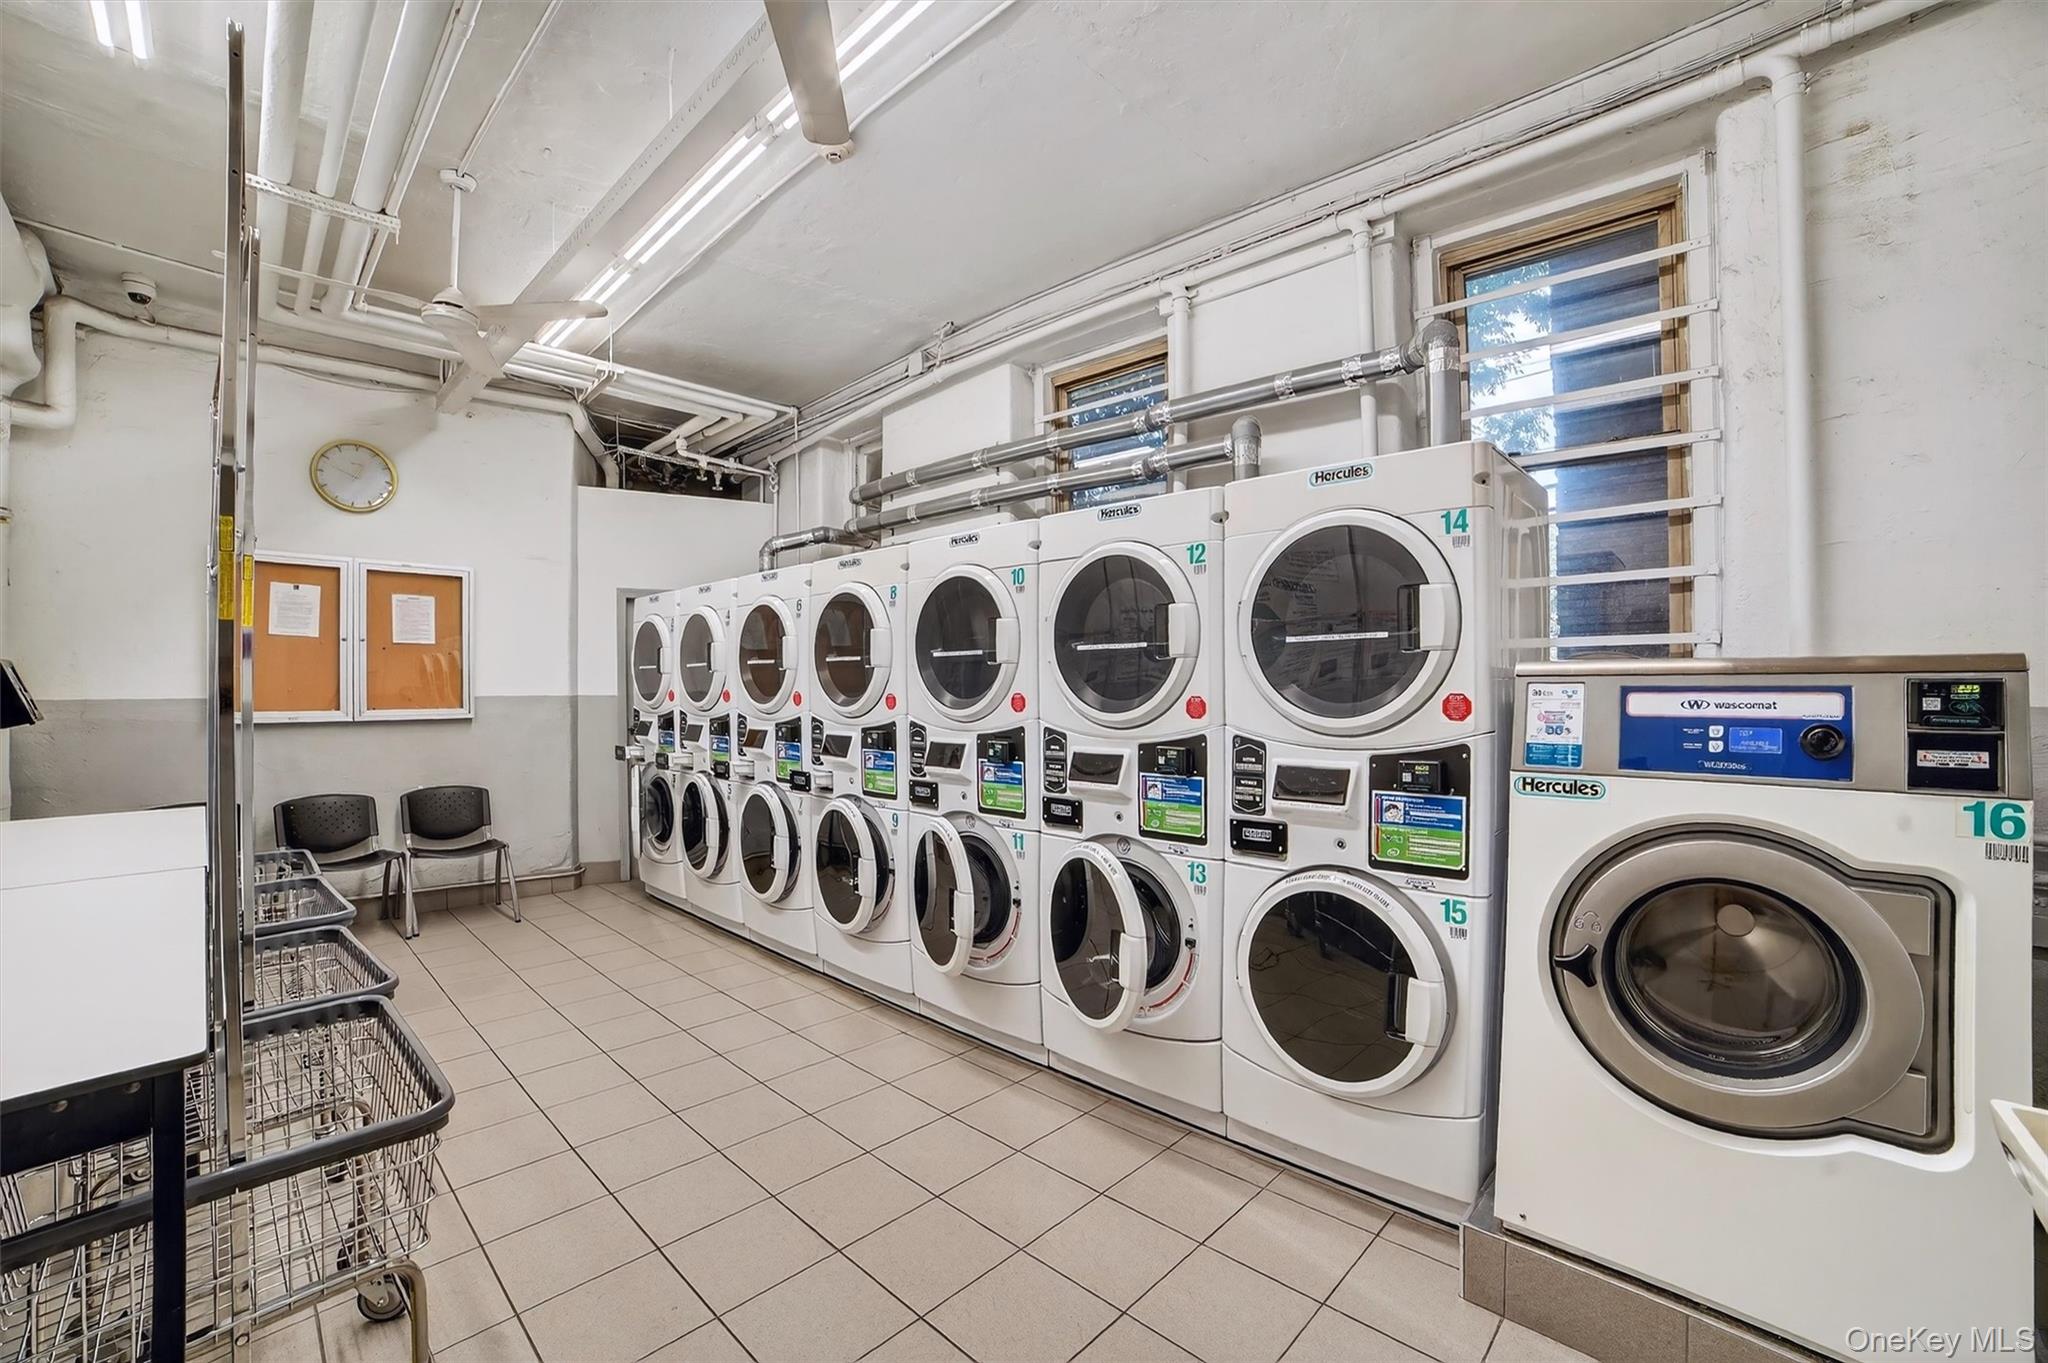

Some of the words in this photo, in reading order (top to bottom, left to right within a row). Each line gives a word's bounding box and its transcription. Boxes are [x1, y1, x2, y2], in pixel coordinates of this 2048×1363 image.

[1314, 465, 1369, 484] Hercules
[1100, 505, 1139, 520] Hercules
[1440, 508, 1469, 534] 14
[1186, 543, 1206, 564] 12
[1011, 567, 1025, 585] 10
[890, 585, 897, 600] 8
[796, 599, 802, 611] 6
[1713, 701, 1778, 710] wascomat
[1522, 777, 1599, 796] Hercules
[891, 812, 899, 828] 9
[1963, 801, 2026, 840] 16
[1012, 832, 1024, 850] 11
[1187, 861, 1206, 884] 13
[1439, 898, 1467, 925] 15
